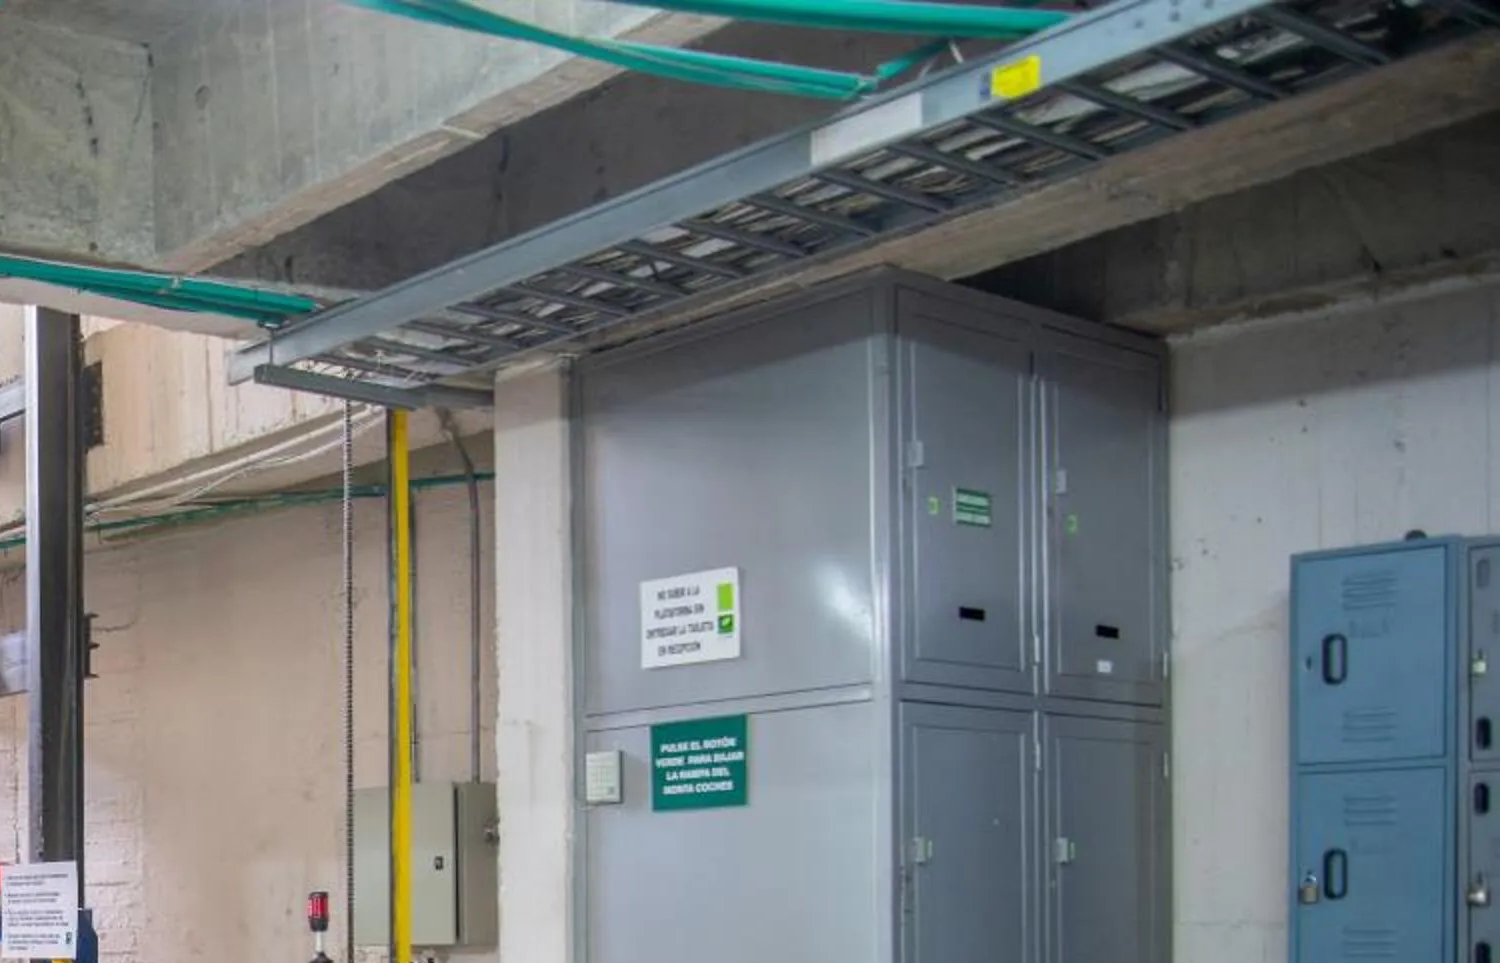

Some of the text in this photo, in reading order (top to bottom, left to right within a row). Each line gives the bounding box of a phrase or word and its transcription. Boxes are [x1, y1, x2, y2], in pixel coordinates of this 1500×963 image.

[660, 742, 688, 753] PULSE
[690, 741, 701, 751] EL
[687, 755, 712, 765] PARA
[665, 771, 679, 781] LA
[711, 767, 730, 777] DEL
